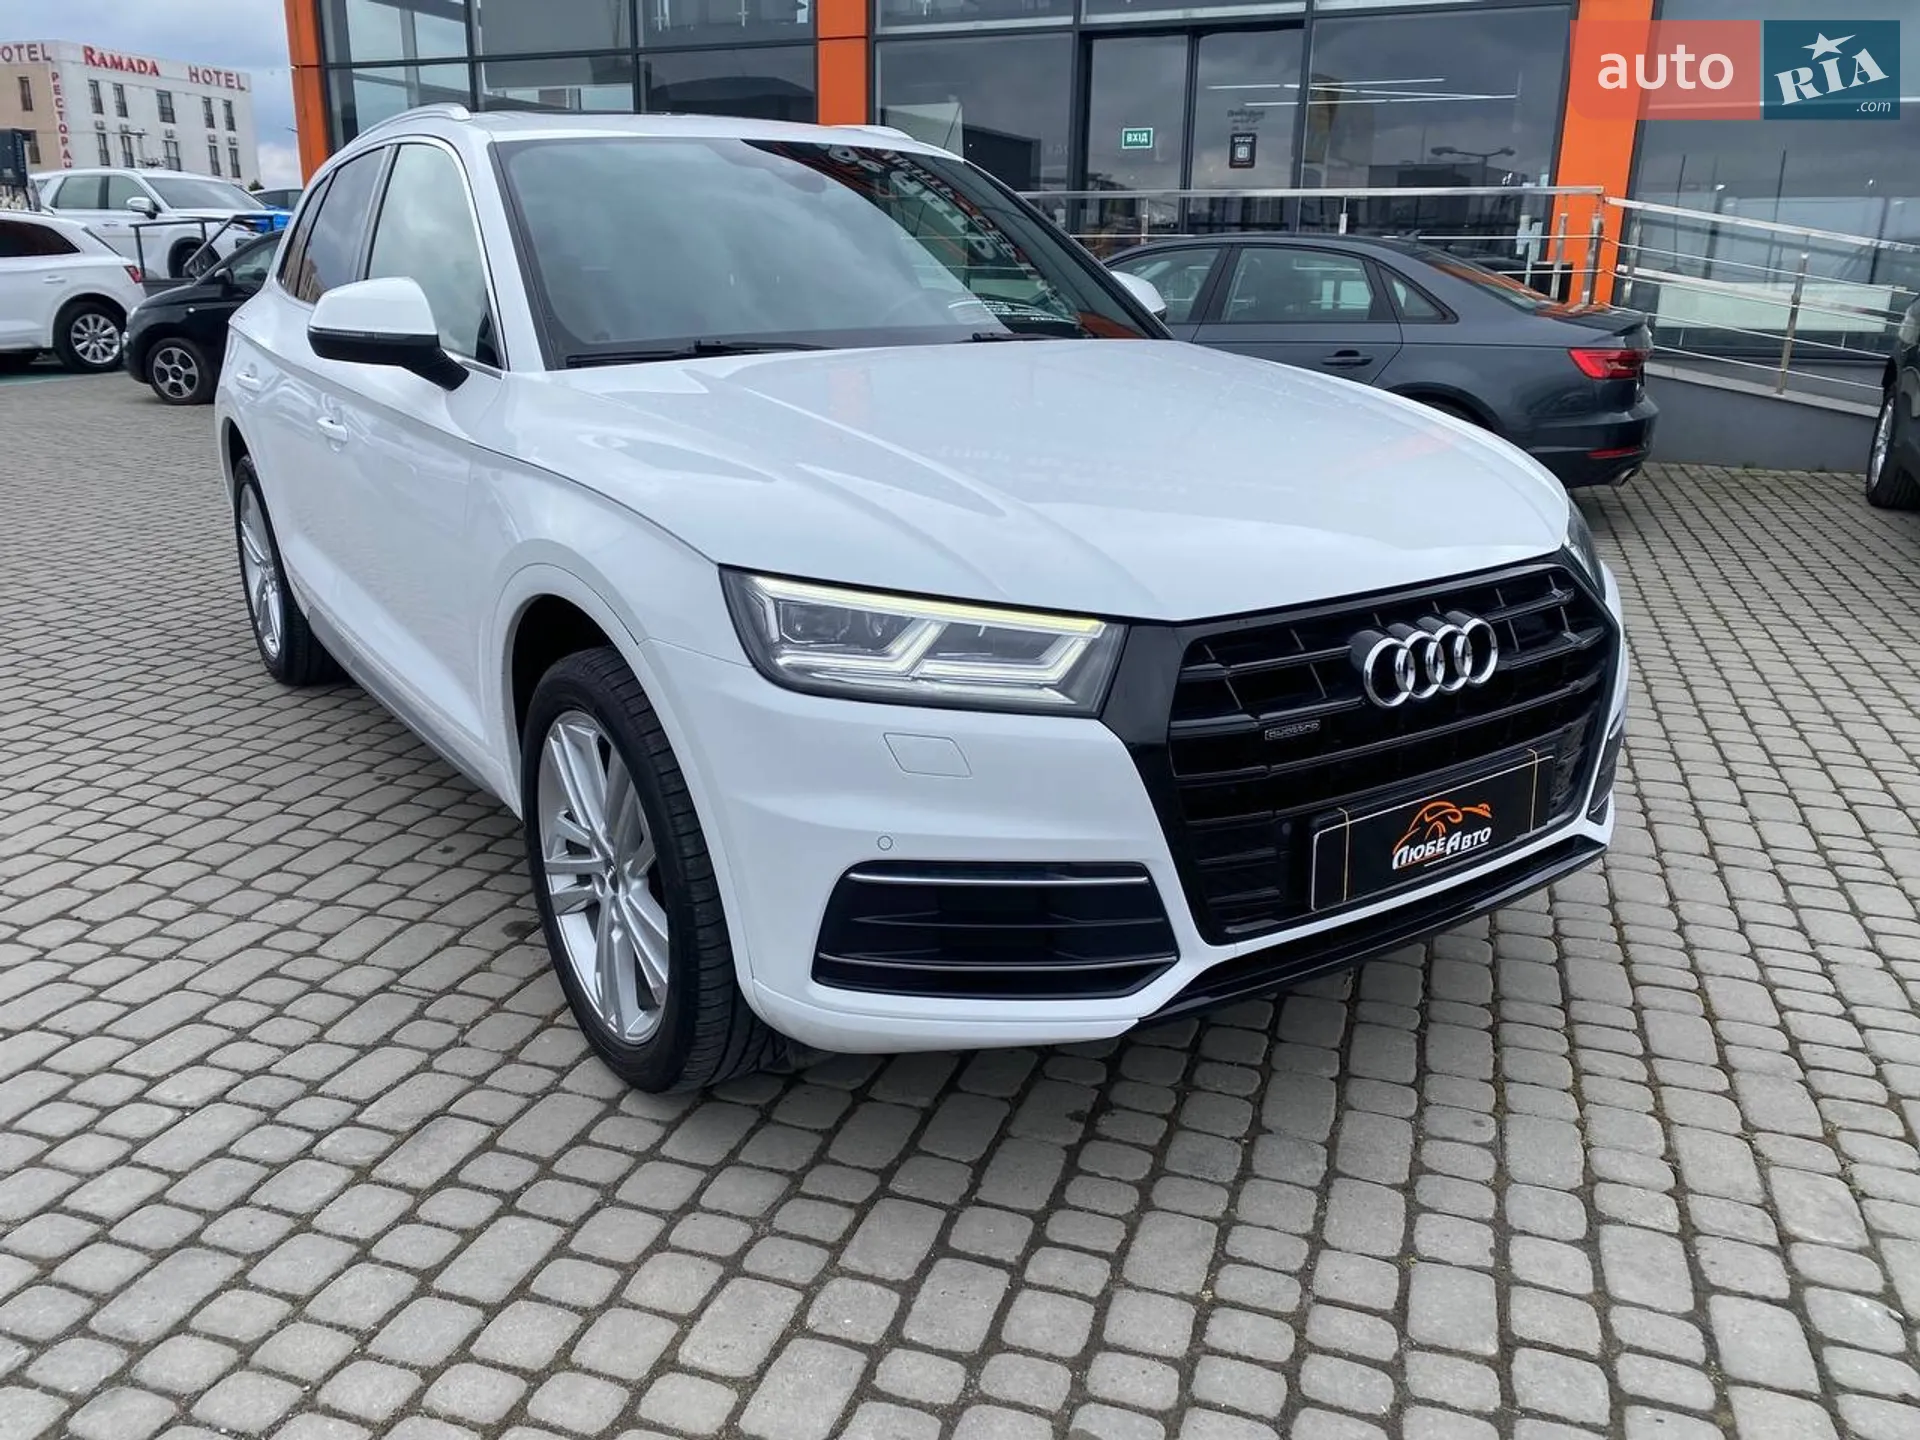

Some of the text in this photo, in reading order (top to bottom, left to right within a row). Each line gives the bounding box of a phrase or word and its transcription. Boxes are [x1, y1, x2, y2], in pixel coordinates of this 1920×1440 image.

[0, 43, 54, 63] OTEL
[83, 45, 246, 91] RAMADA HOTEL
[1126, 131, 1149, 144] ВХІД
